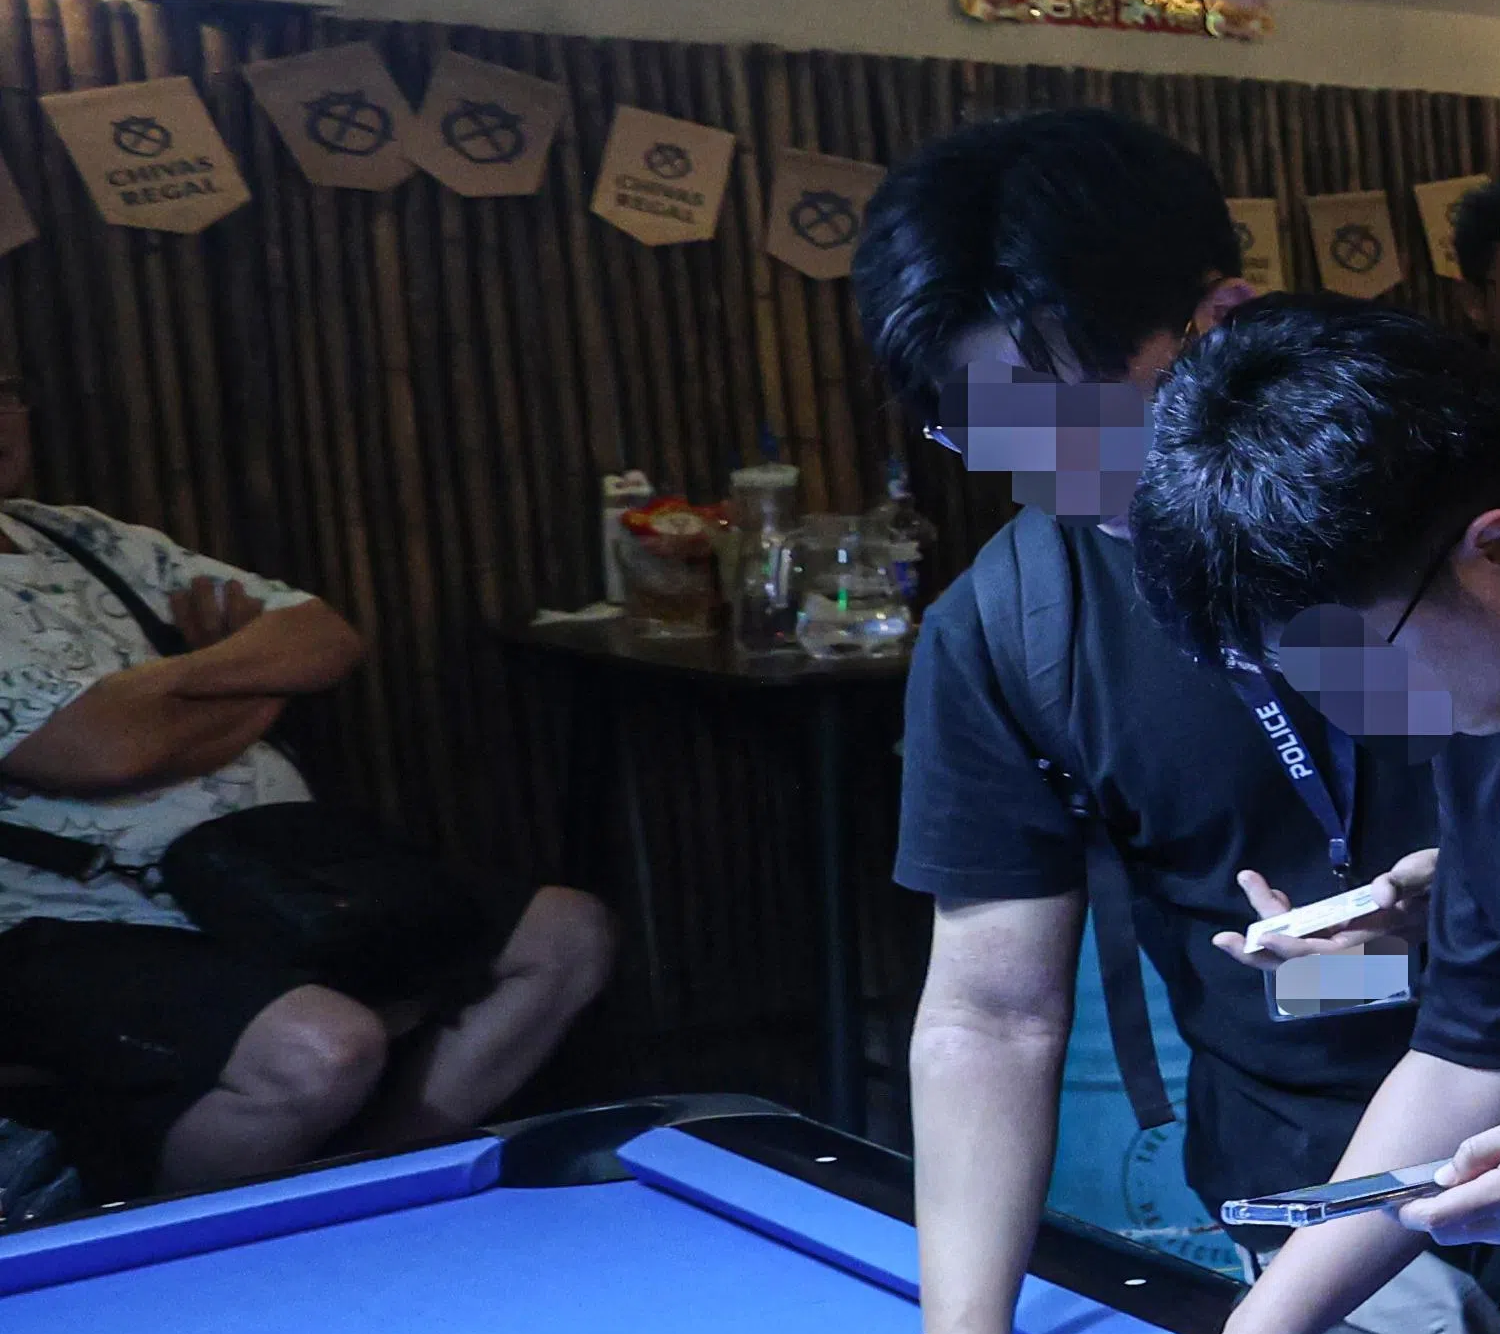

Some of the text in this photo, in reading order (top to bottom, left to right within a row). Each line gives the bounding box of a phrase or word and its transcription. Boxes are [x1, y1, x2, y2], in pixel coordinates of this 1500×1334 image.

[107, 156, 214, 187] CHIVAS
[120, 178, 221, 206] REGAL
[1255, 701, 1314, 779] POLICE
